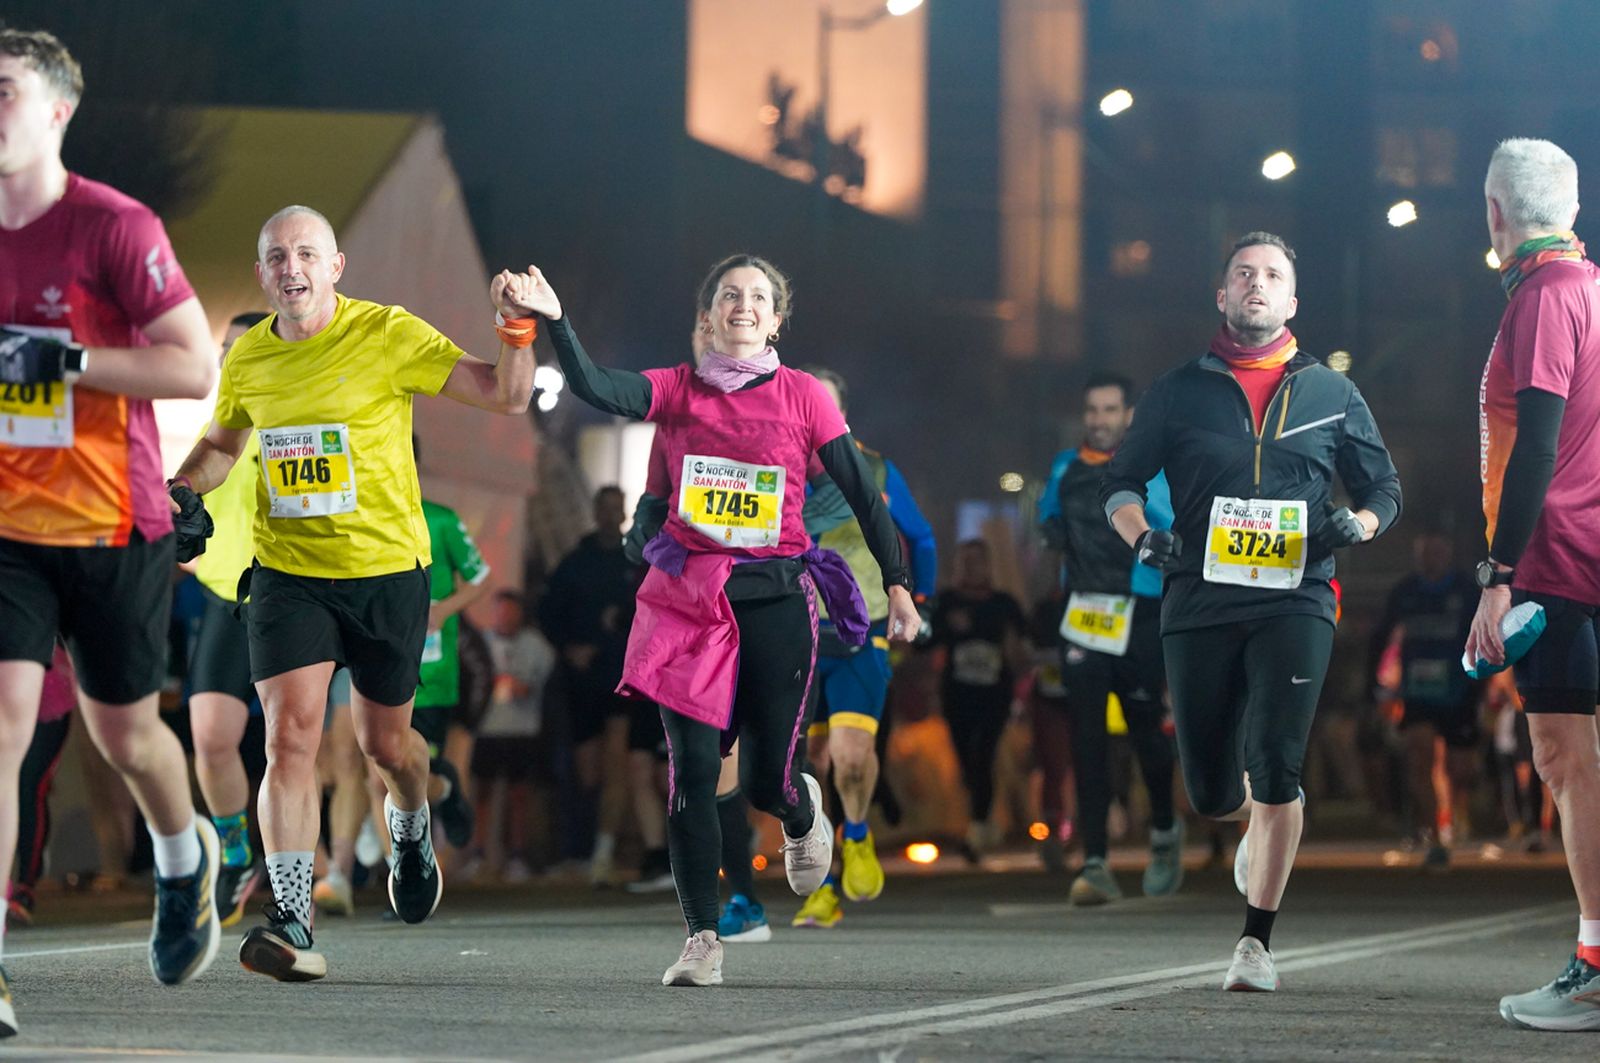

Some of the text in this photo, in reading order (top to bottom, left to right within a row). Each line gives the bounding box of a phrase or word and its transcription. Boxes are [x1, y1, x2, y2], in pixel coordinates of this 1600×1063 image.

[0, 382, 52, 405] 201
[274, 436, 302, 447] NOCHE
[303, 435, 313, 445] DE
[268, 450, 283, 459] SAN
[283, 444, 315, 458] ANTÓN
[278, 457, 331, 486] 1746
[706, 466, 735, 478] NOCHE
[736, 470, 749, 479] DE
[693, 476, 712, 487] SAN
[714, 478, 747, 490] ANTÓN
[704, 489, 759, 518] 1745
[1233, 508, 1260, 518] NOCE
[1261, 510, 1273, 519] DE
[1220, 517, 1239, 527] SAN
[1241, 519, 1272, 530] ANTÓN
[1228, 530, 1287, 559] 3724
